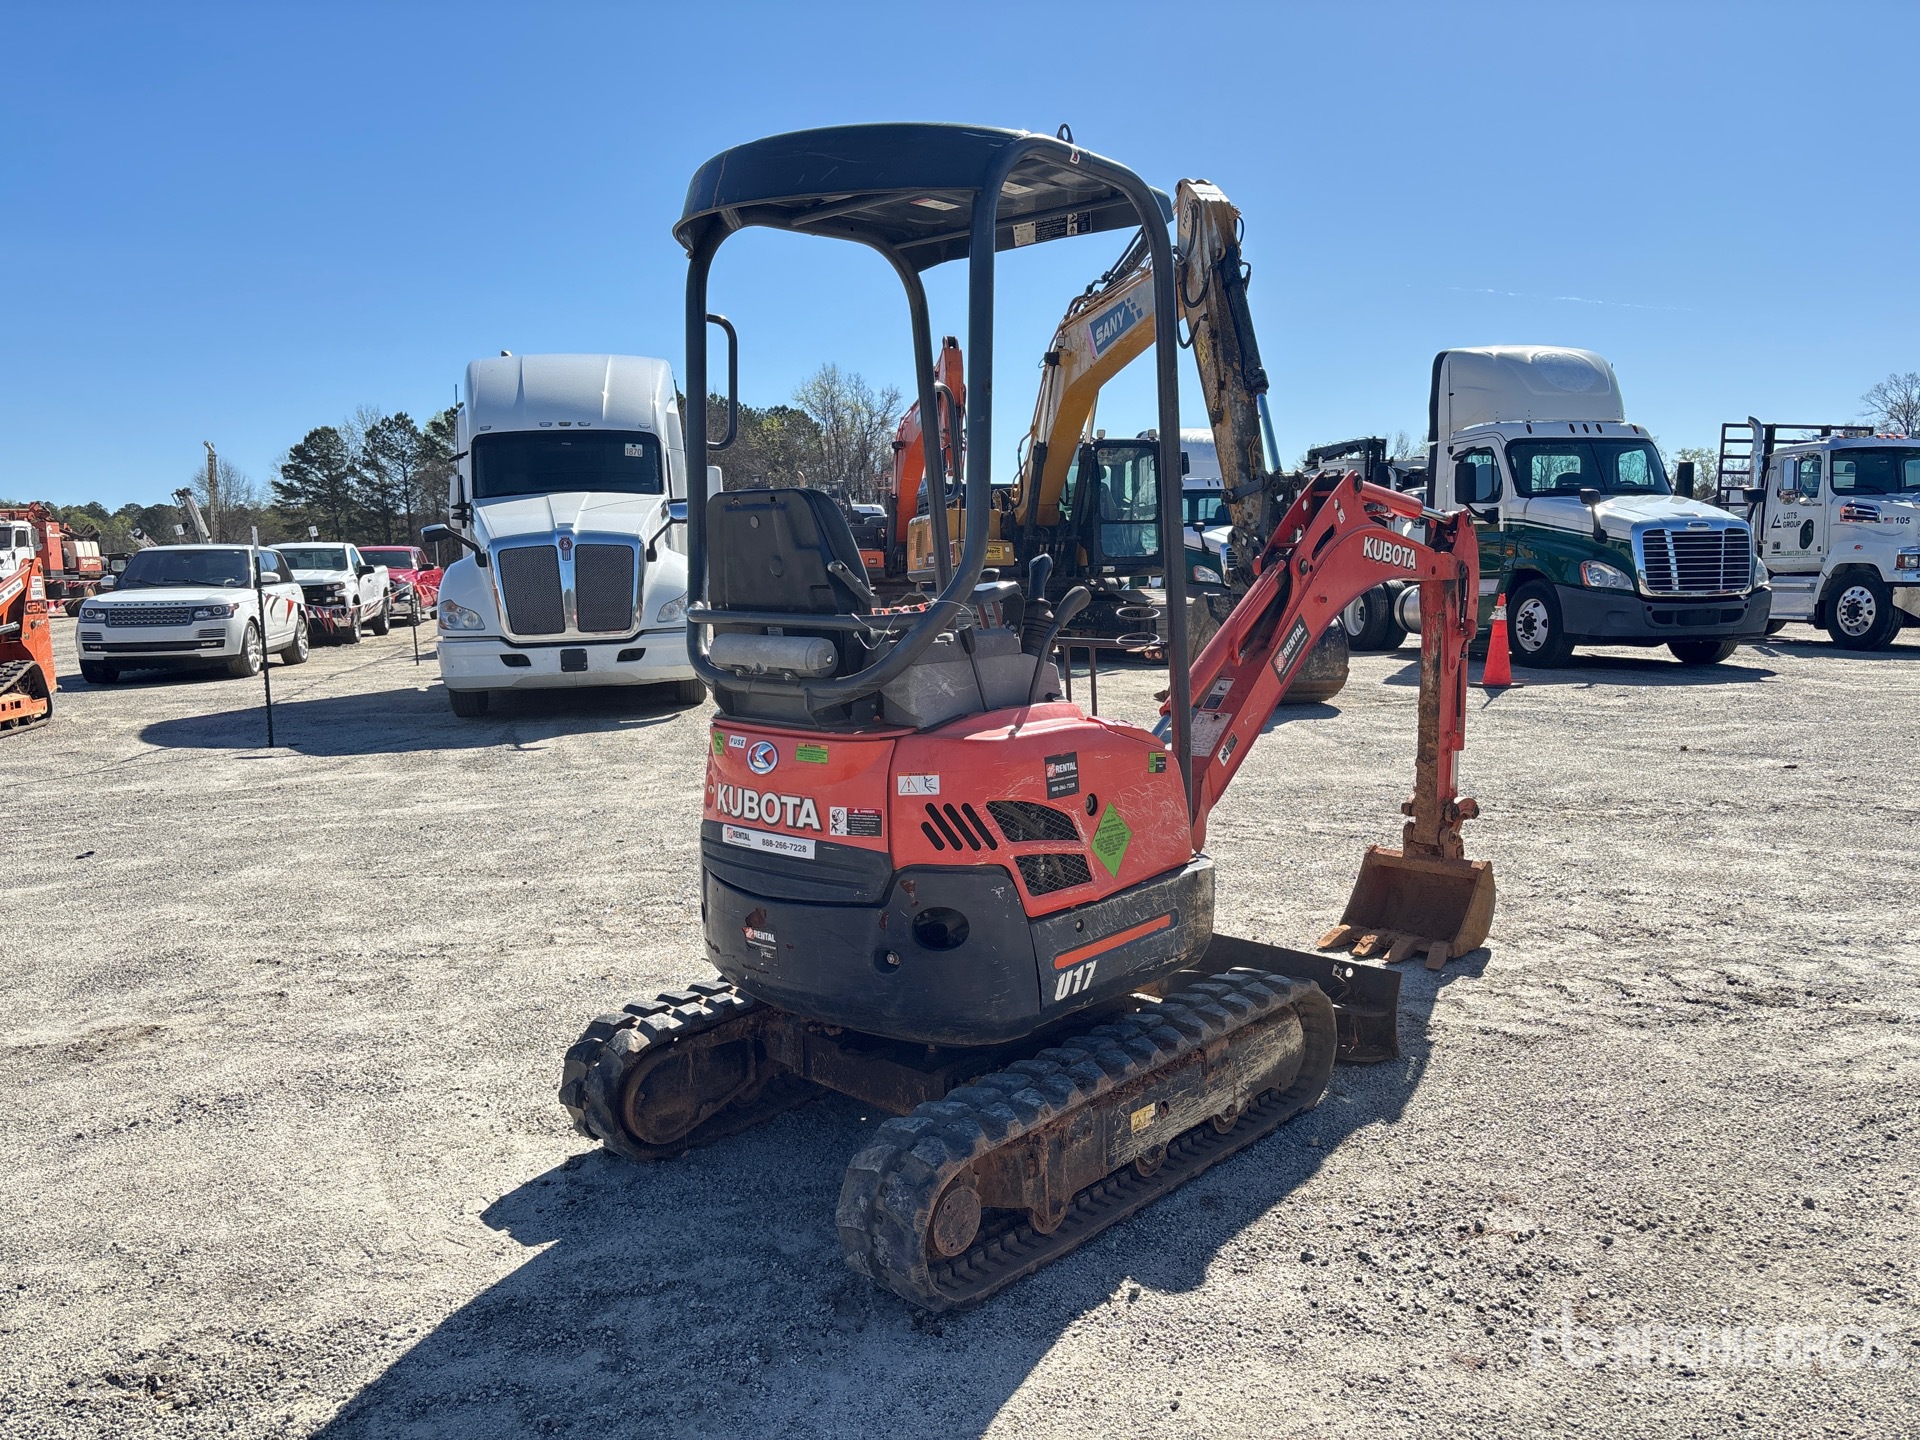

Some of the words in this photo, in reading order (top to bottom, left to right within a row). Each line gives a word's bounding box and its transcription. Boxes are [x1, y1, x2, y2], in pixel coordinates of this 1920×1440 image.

[1096, 307, 1125, 346] SANY
[626, 447, 642, 456] 1870
[1783, 512, 1798, 520] LOTS
[1895, 516, 1911, 524] 105
[1783, 520, 1801, 528] GROUP
[1363, 536, 1416, 570] KUBOTA
[26, 602, 47, 613] GEHL
[1282, 624, 1305, 659] RENTAL
[730, 737, 745, 746] FUSE
[1055, 762, 1077, 773] RENTAL
[717, 783, 822, 830] KUBOTA
[733, 830, 751, 841] RENTAL
[761, 838, 807, 853] 888-266-7228
[753, 930, 776, 943] RENTAL
[1055, 960, 1097, 1001] U17
